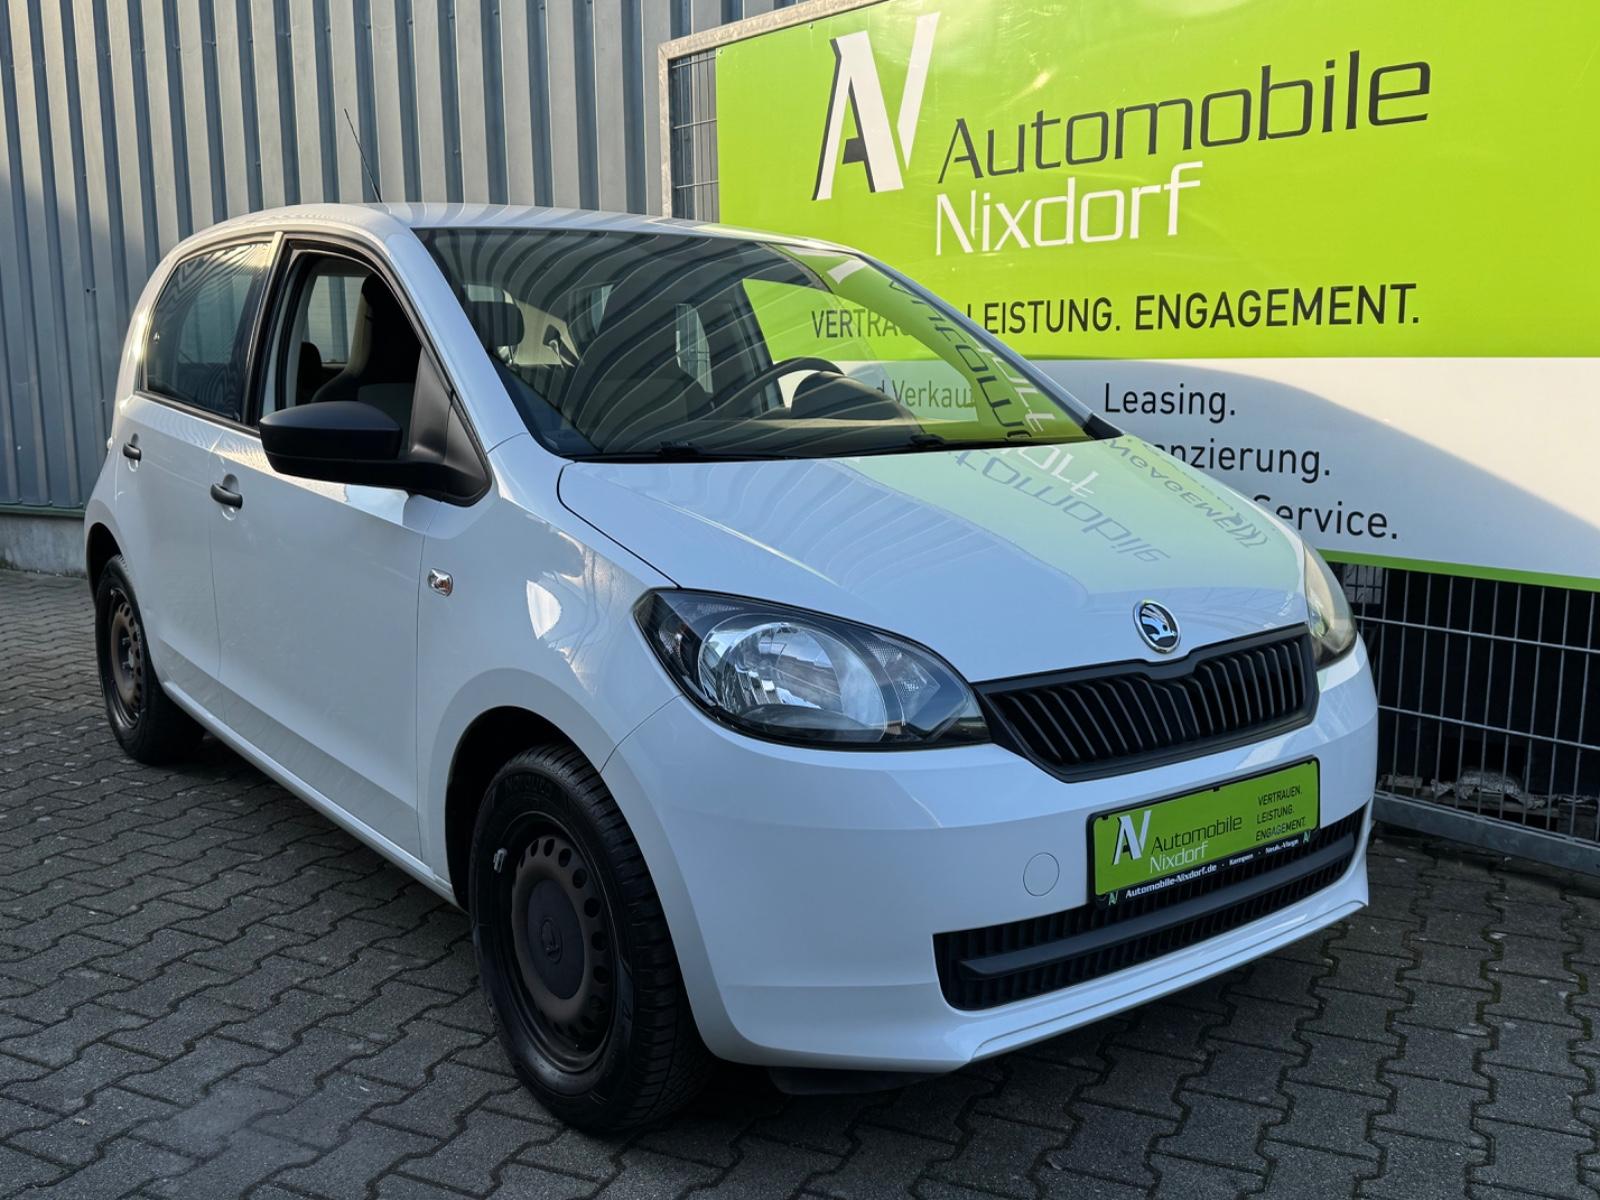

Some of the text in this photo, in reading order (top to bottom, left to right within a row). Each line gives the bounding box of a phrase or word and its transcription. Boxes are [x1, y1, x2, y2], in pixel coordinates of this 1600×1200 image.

[938, 50, 1432, 184] Automobile
[936, 161, 1204, 256] Nixdorf
[811, 308, 911, 339] VERTRA
[1136, 283, 1420, 332] ENGAGEMENT.
[1104, 383, 1236, 424] Leasing.
[1153, 438, 1331, 482] nzierung.
[1253, 494, 1398, 540] ervice.
[1256, 804, 1295, 825] LEISTUNG.
[1257, 785, 1303, 806] VERTRAUEN.
[1150, 815, 1243, 854] Automobile
[1149, 840, 1209, 874] Nixdorf
[1125, 864, 1217, 898] Automobile-Nixdorf.de
